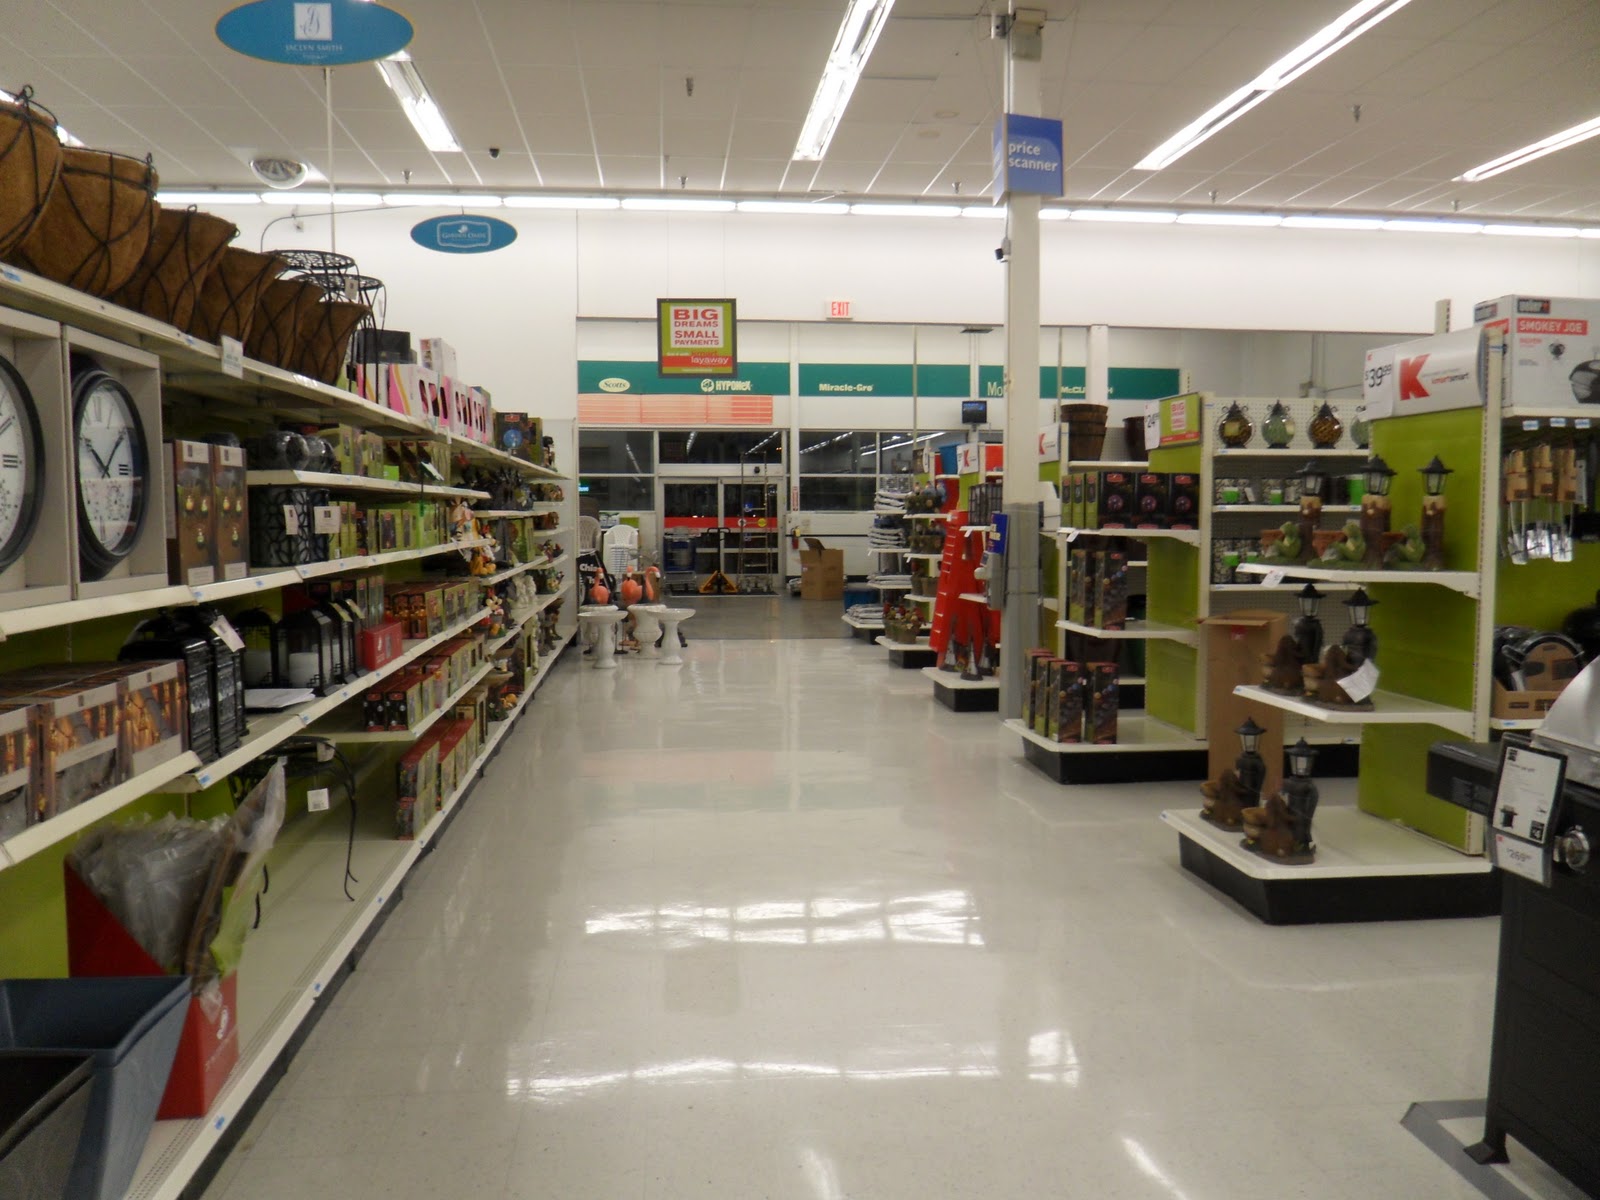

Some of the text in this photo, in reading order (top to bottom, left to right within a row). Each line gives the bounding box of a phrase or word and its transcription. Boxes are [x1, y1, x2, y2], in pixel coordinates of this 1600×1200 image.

[1008, 141, 1040, 155] price
[1008, 157, 1058, 171] scanner
[674, 308, 718, 320] BIG
[831, 301, 849, 316] EXIT
[674, 320, 719, 328] DREAMS
[1519, 319, 1562, 331] SMOKEY
[1563, 322, 1583, 333] JOE
[674, 330, 719, 339] SMALL
[691, 355, 729, 365] layaway
[1400, 353, 1431, 401] K
[819, 383, 873, 392] Miracle-Gro
